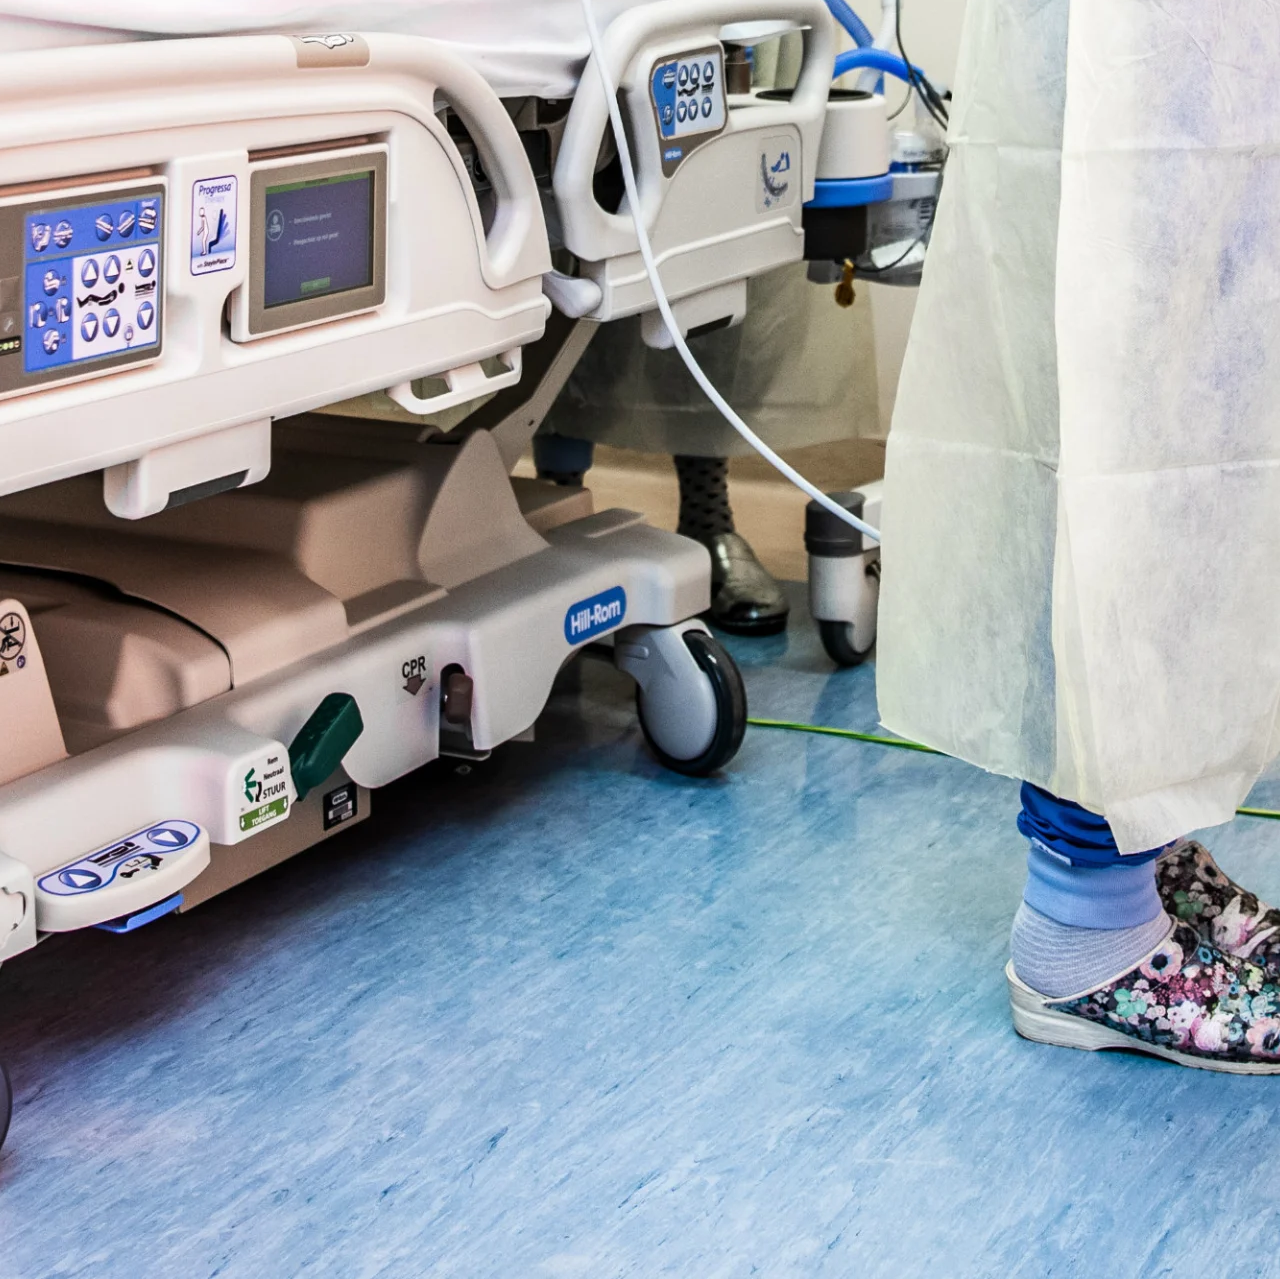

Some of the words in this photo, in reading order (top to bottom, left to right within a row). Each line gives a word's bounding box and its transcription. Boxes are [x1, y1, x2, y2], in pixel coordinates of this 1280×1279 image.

[199, 182, 232, 197] Progressa
[571, 599, 621, 636] Hill-Rom
[401, 655, 426, 678] CPR
[267, 756, 279, 765] Rem
[263, 766, 285, 780] Neutraal
[262, 781, 286, 799] STUUR
[258, 805, 270, 815] LIFT
[251, 810, 277, 826] TOEGANG
